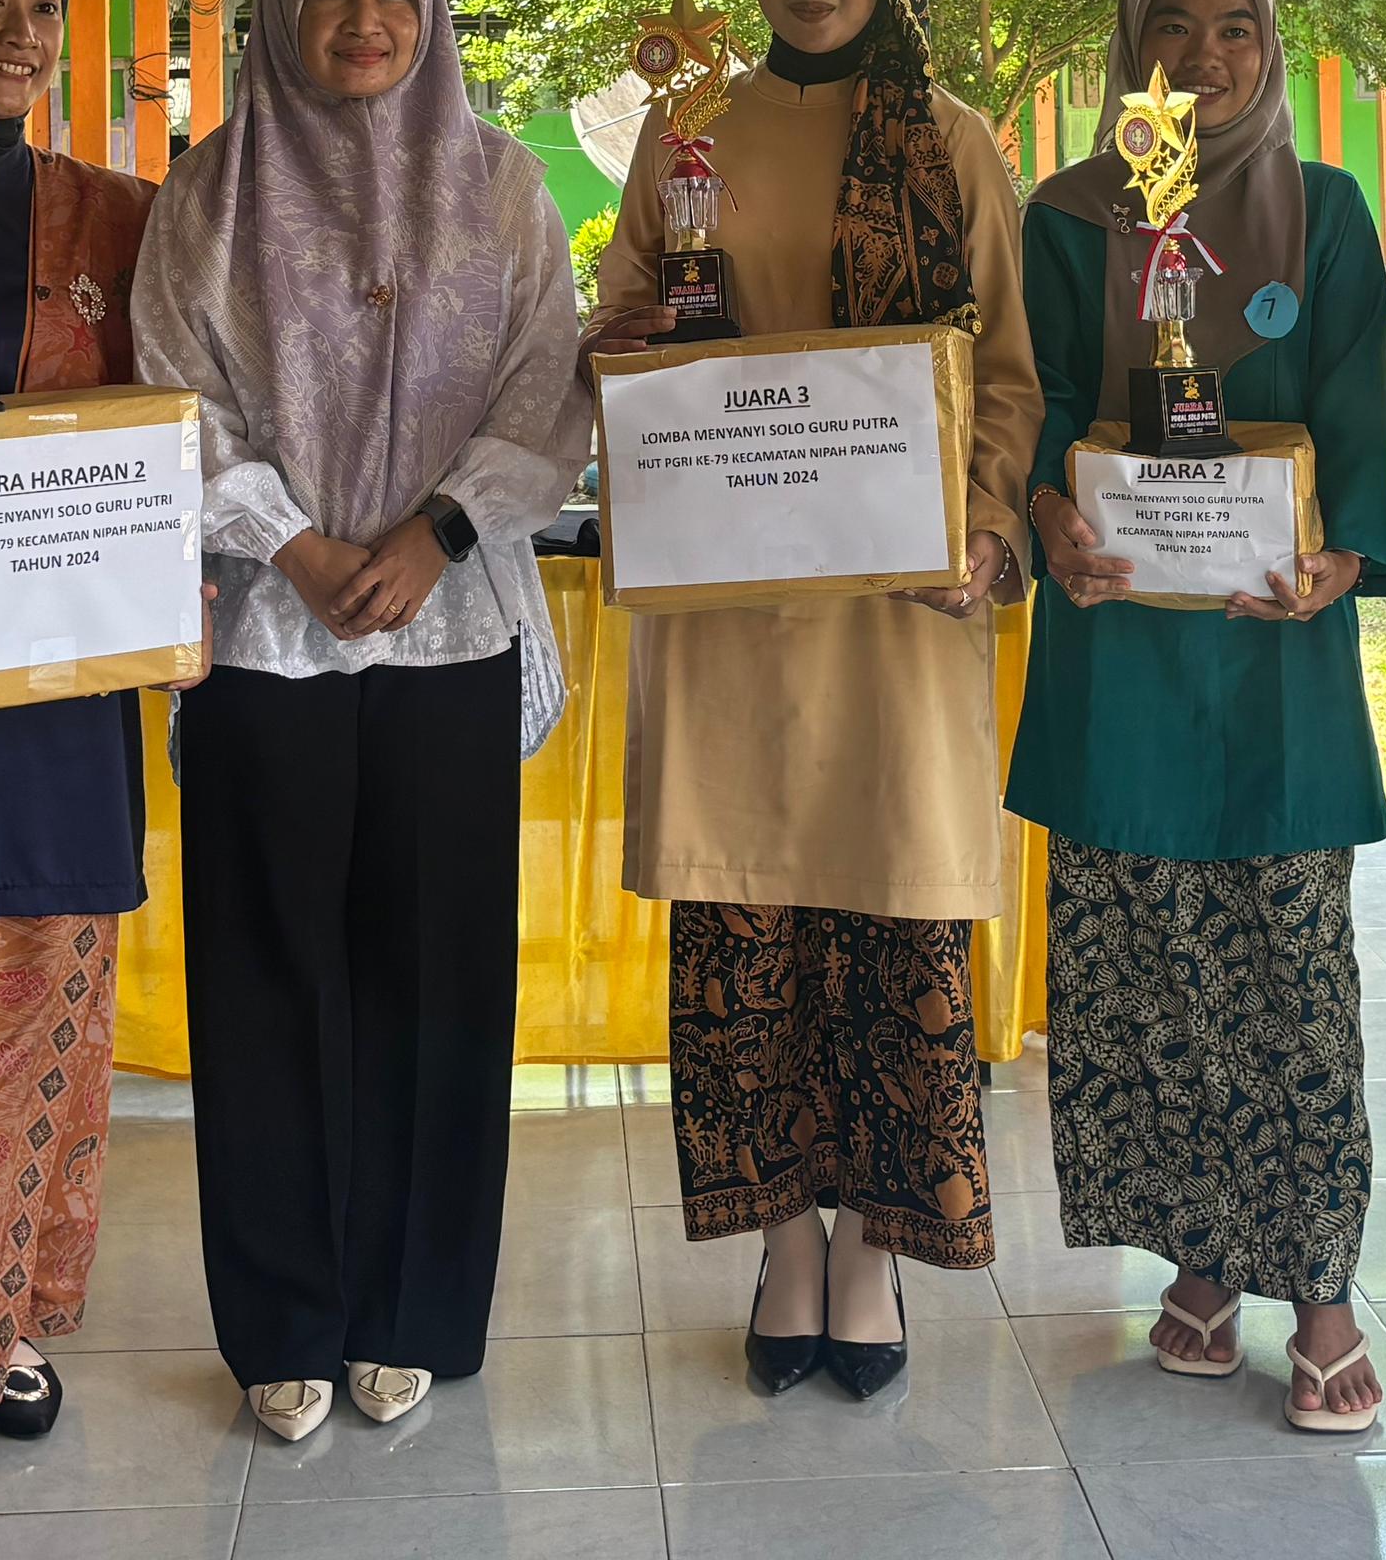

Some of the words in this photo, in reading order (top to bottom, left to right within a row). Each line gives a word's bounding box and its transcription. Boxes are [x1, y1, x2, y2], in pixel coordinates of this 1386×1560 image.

[1261, 298, 1276, 320] 7
[724, 387, 791, 408] JUARA
[797, 385, 809, 403] 3
[641, 430, 690, 444] LOMBA
[694, 425, 765, 440] MENYANYI
[769, 422, 804, 436] SOLO
[808, 419, 848, 433] GURU
[852, 416, 898, 430] PUTRA
[637, 458, 661, 469] HUT
[664, 456, 692, 468] PGRI
[695, 453, 728, 465] KE-79
[732, 448, 805, 463] KECAMATAN
[809, 446, 846, 458] NIPAH
[850, 442, 906, 455] PANJANG
[31, 462, 127, 489] HARAPAN
[134, 460, 145, 478] 2
[725, 472, 778, 487] TAHUN
[782, 469, 818, 484] 2024
[1137, 463, 1206, 481] JUARA
[1213, 462, 1225, 479] 2
[57, 503, 91, 517] SOLO
[95, 498, 132, 513] GURU
[136, 493, 171, 508] PUTRI
[1101, 492, 1132, 501] LOMBA
[1134, 494, 1179, 503] MENYANYI
[1182, 495, 1204, 503] SOLO
[1207, 496, 1232, 504] GURU
[1235, 496, 1264, 504] PUTRA
[1135, 509, 1161, 520] HUT
[1163, 511, 1192, 521] PGRI
[1196, 511, 1229, 521] KE-79
[17, 529, 89, 547] KECAMATAN
[92, 525, 127, 538] NIPAH
[130, 518, 180, 534] PANJANG
[1116, 526, 1173, 538] KECAMATAN
[1175, 530, 1204, 538] NIPAH
[1206, 530, 1249, 538] PANJANG
[1154, 543, 1186, 552] TAHUN
[1189, 544, 1211, 553] 2024
[10, 554, 61, 572] TAHUN
[66, 550, 99, 566] 2024
